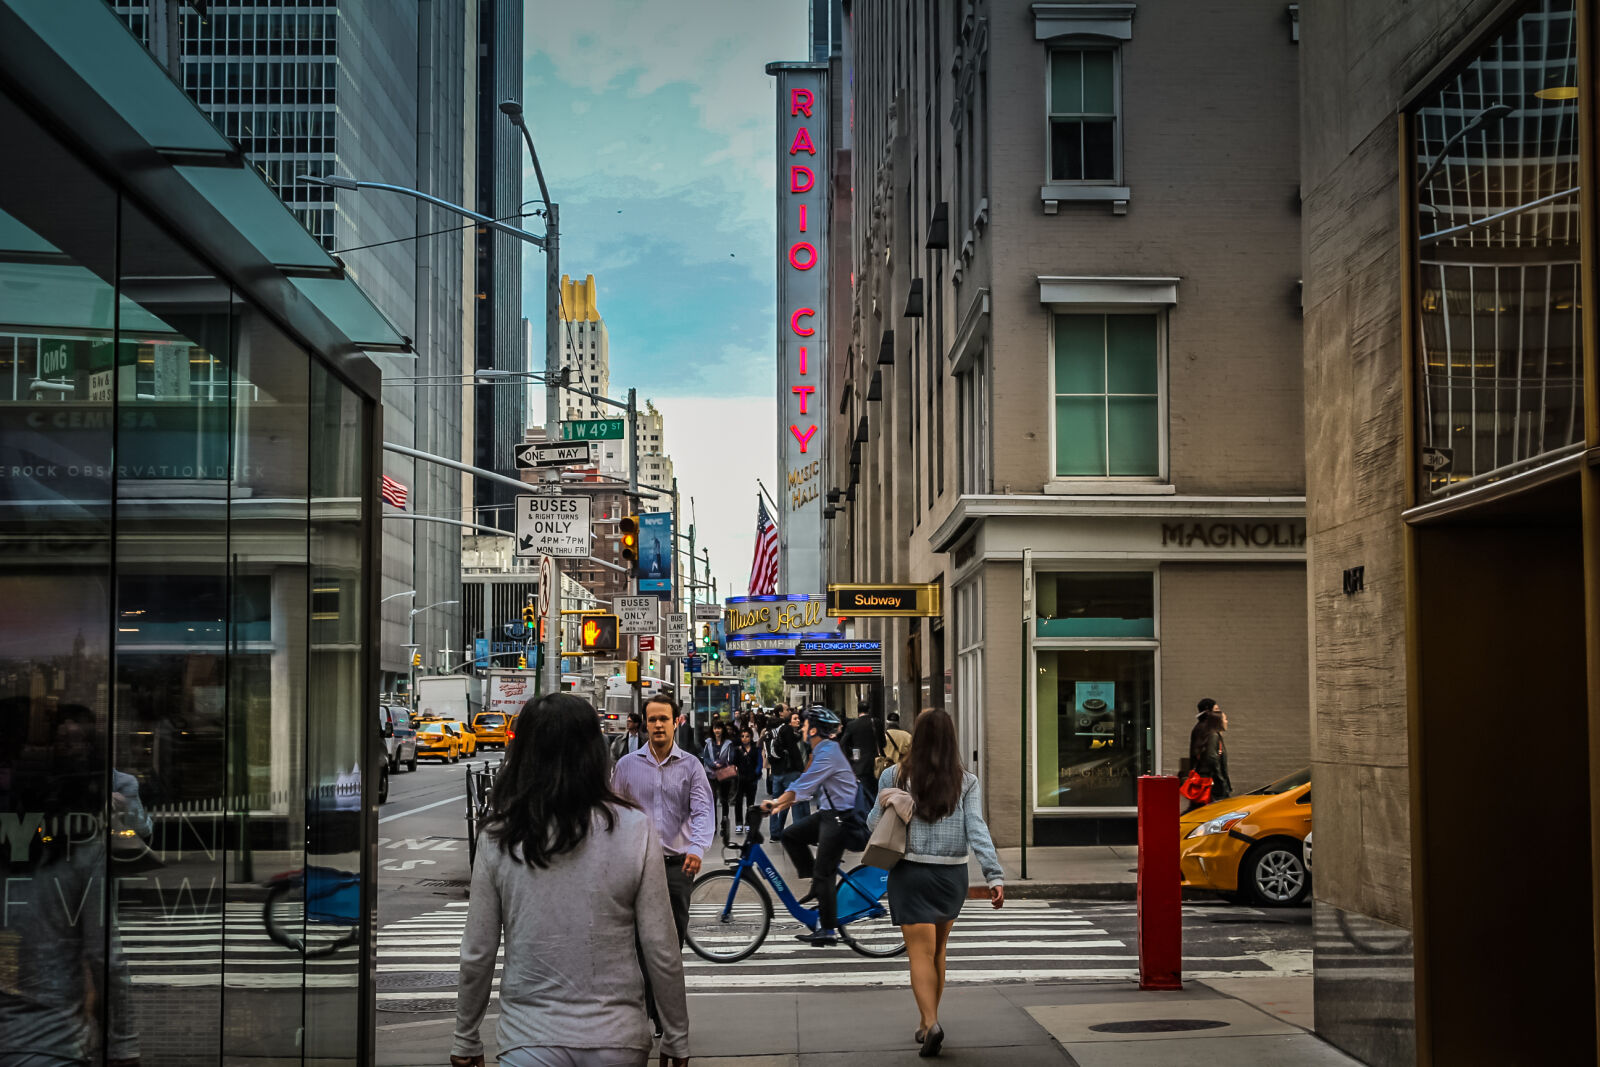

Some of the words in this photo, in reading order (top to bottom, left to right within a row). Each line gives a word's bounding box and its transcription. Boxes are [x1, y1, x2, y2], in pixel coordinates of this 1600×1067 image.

[789, 88, 818, 270] RADIO
[43, 344, 67, 374] QM6
[789, 307, 818, 453] CITY
[576, 425, 586, 438] W
[589, 423, 607, 437] 49
[611, 422, 621, 431] ST
[525, 450, 546, 462] ONE
[557, 448, 579, 459] WAY
[11, 465, 57, 478] ROCK
[788, 461, 819, 491] MUSIC
[792, 484, 819, 511] HALL
[530, 500, 577, 512] BUSES
[534, 521, 572, 534] ONLY
[645, 518, 664, 526] NYC
[1161, 521, 1307, 548] MAGNOLI
[536, 546, 553, 554] MON
[575, 546, 587, 554] FRI
[621, 598, 650, 607] BUSES
[854, 594, 901, 607] Subway
[624, 612, 647, 620] ONLY
[726, 606, 771, 633] Music
[799, 662, 844, 677] NBC
